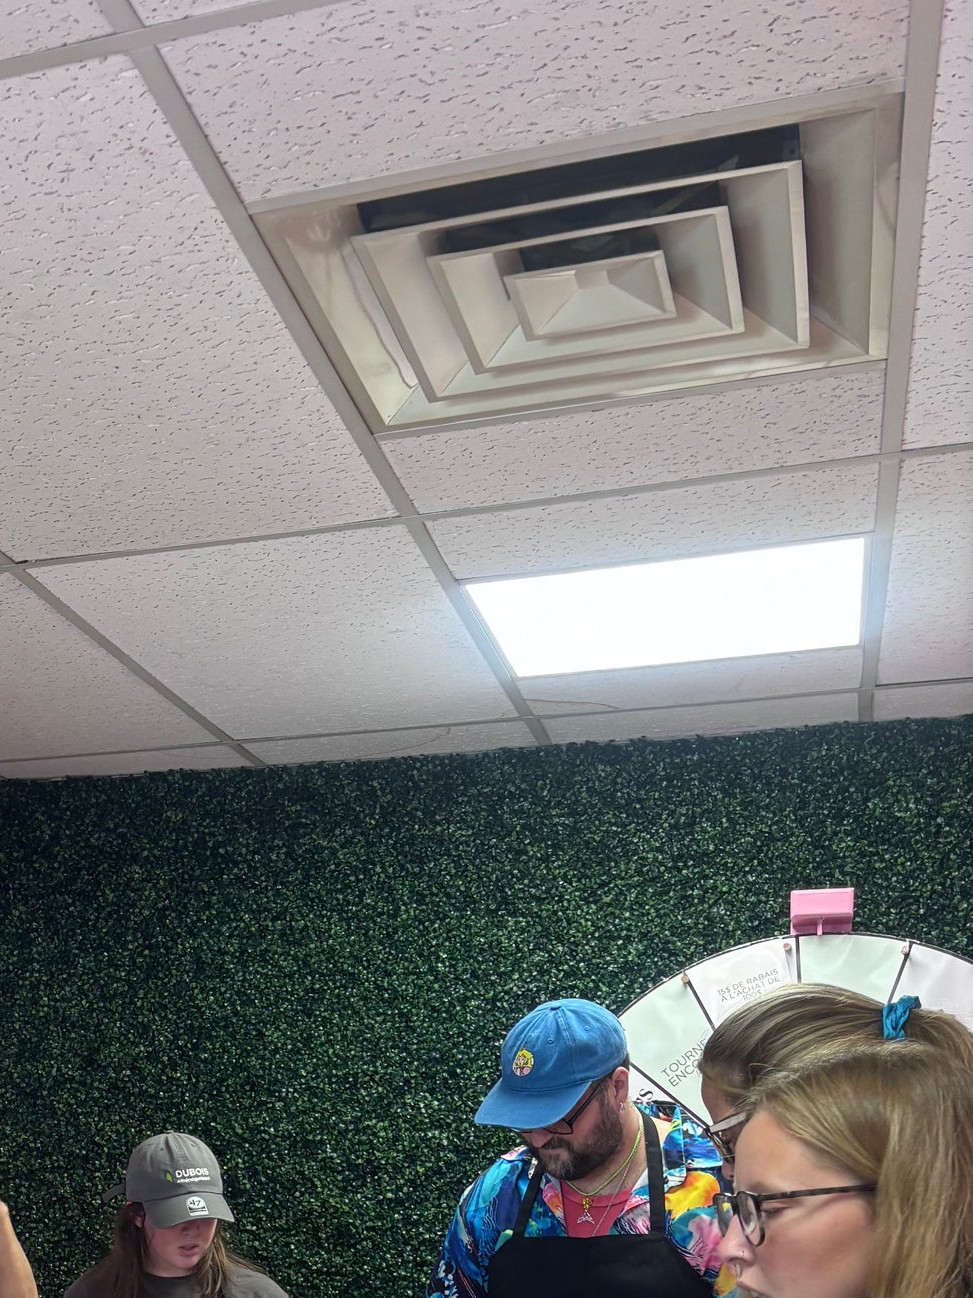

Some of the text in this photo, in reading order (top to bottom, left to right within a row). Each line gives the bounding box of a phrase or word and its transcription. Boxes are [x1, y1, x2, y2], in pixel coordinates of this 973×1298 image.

[732, 980, 745, 991] DE
[746, 968, 779, 986] RABAIS
[767, 976, 780, 986] DE
[661, 1038, 707, 1079] TOURNE
[668, 1059, 700, 1087] ENCO
[175, 1167, 209, 1178] DUBOIS
